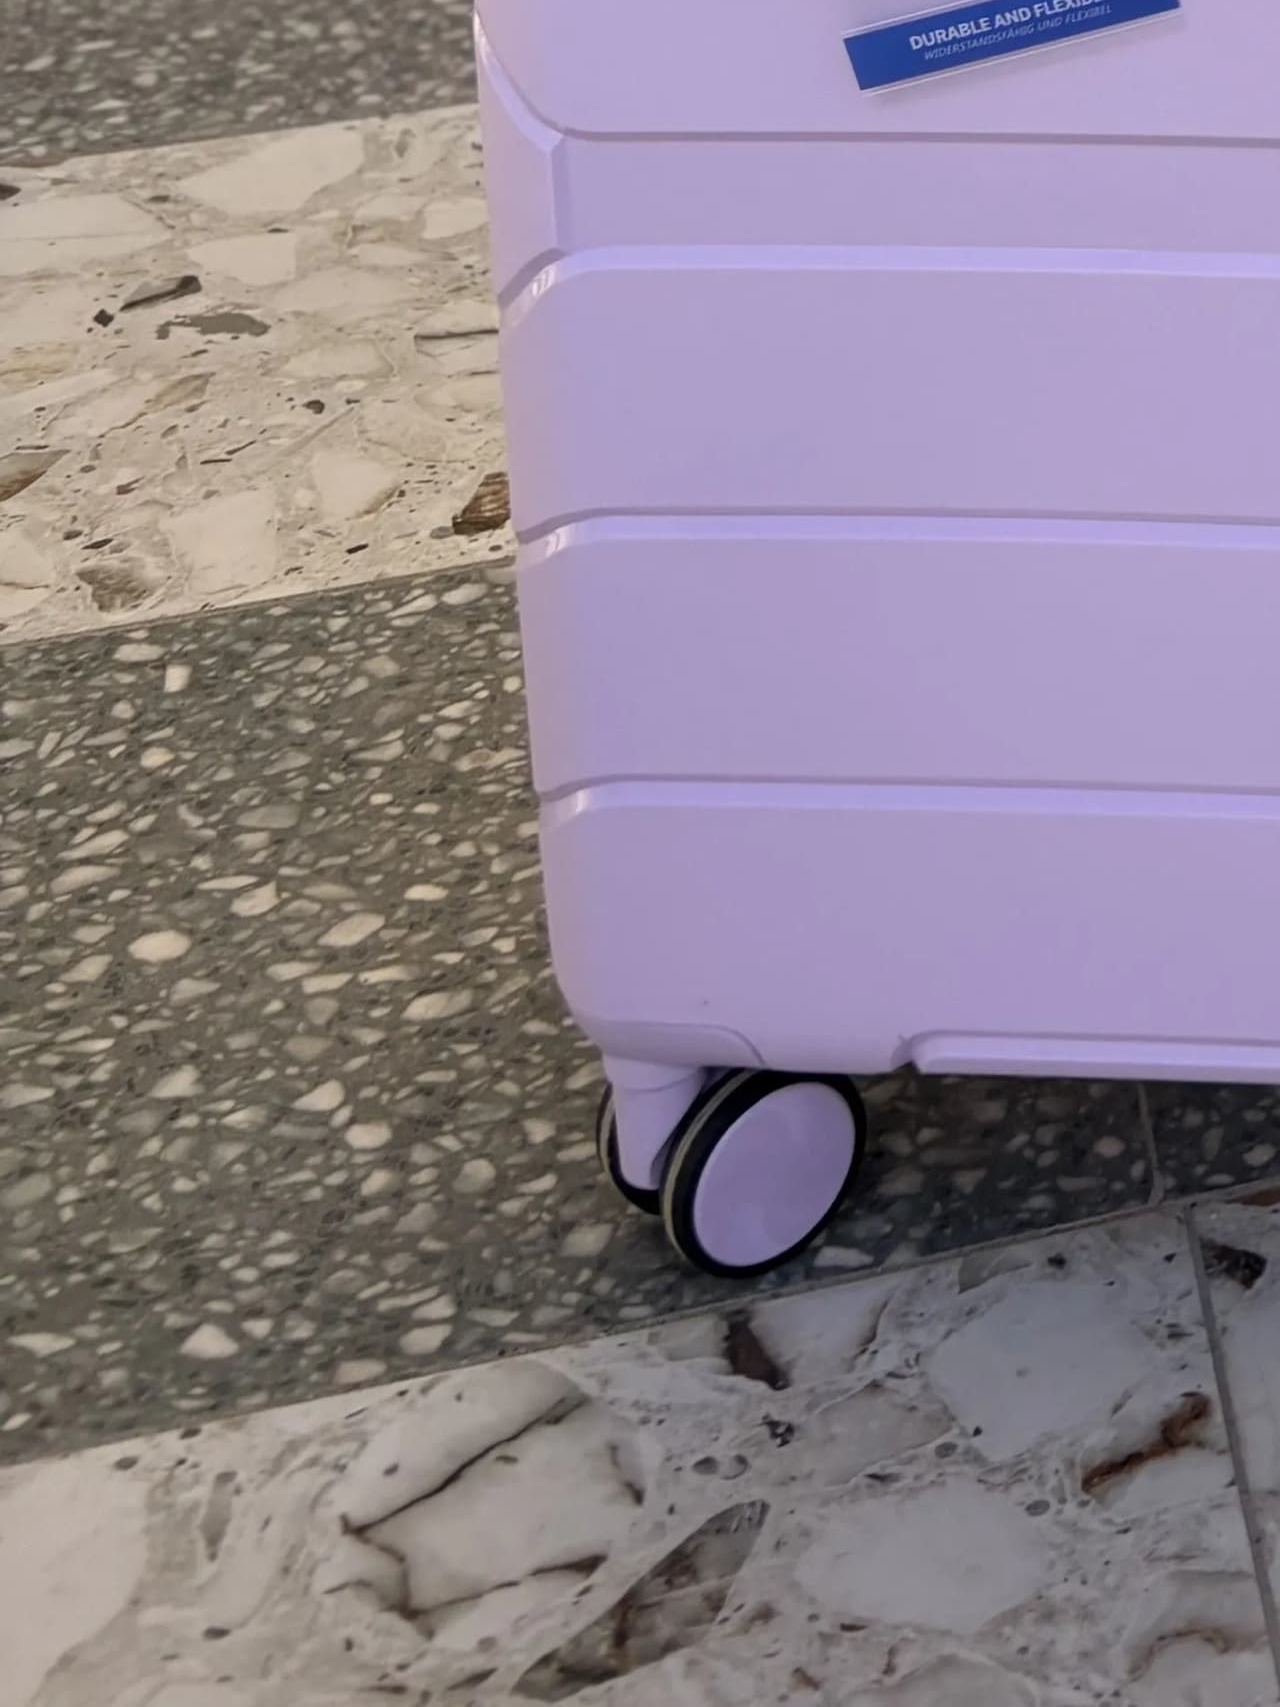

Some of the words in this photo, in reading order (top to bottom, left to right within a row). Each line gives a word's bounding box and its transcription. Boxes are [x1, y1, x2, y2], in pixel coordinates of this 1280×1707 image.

[909, 17, 993, 51] DURABLE
[993, 6, 1032, 29] AND
[1037, 16, 1063, 31] UND
